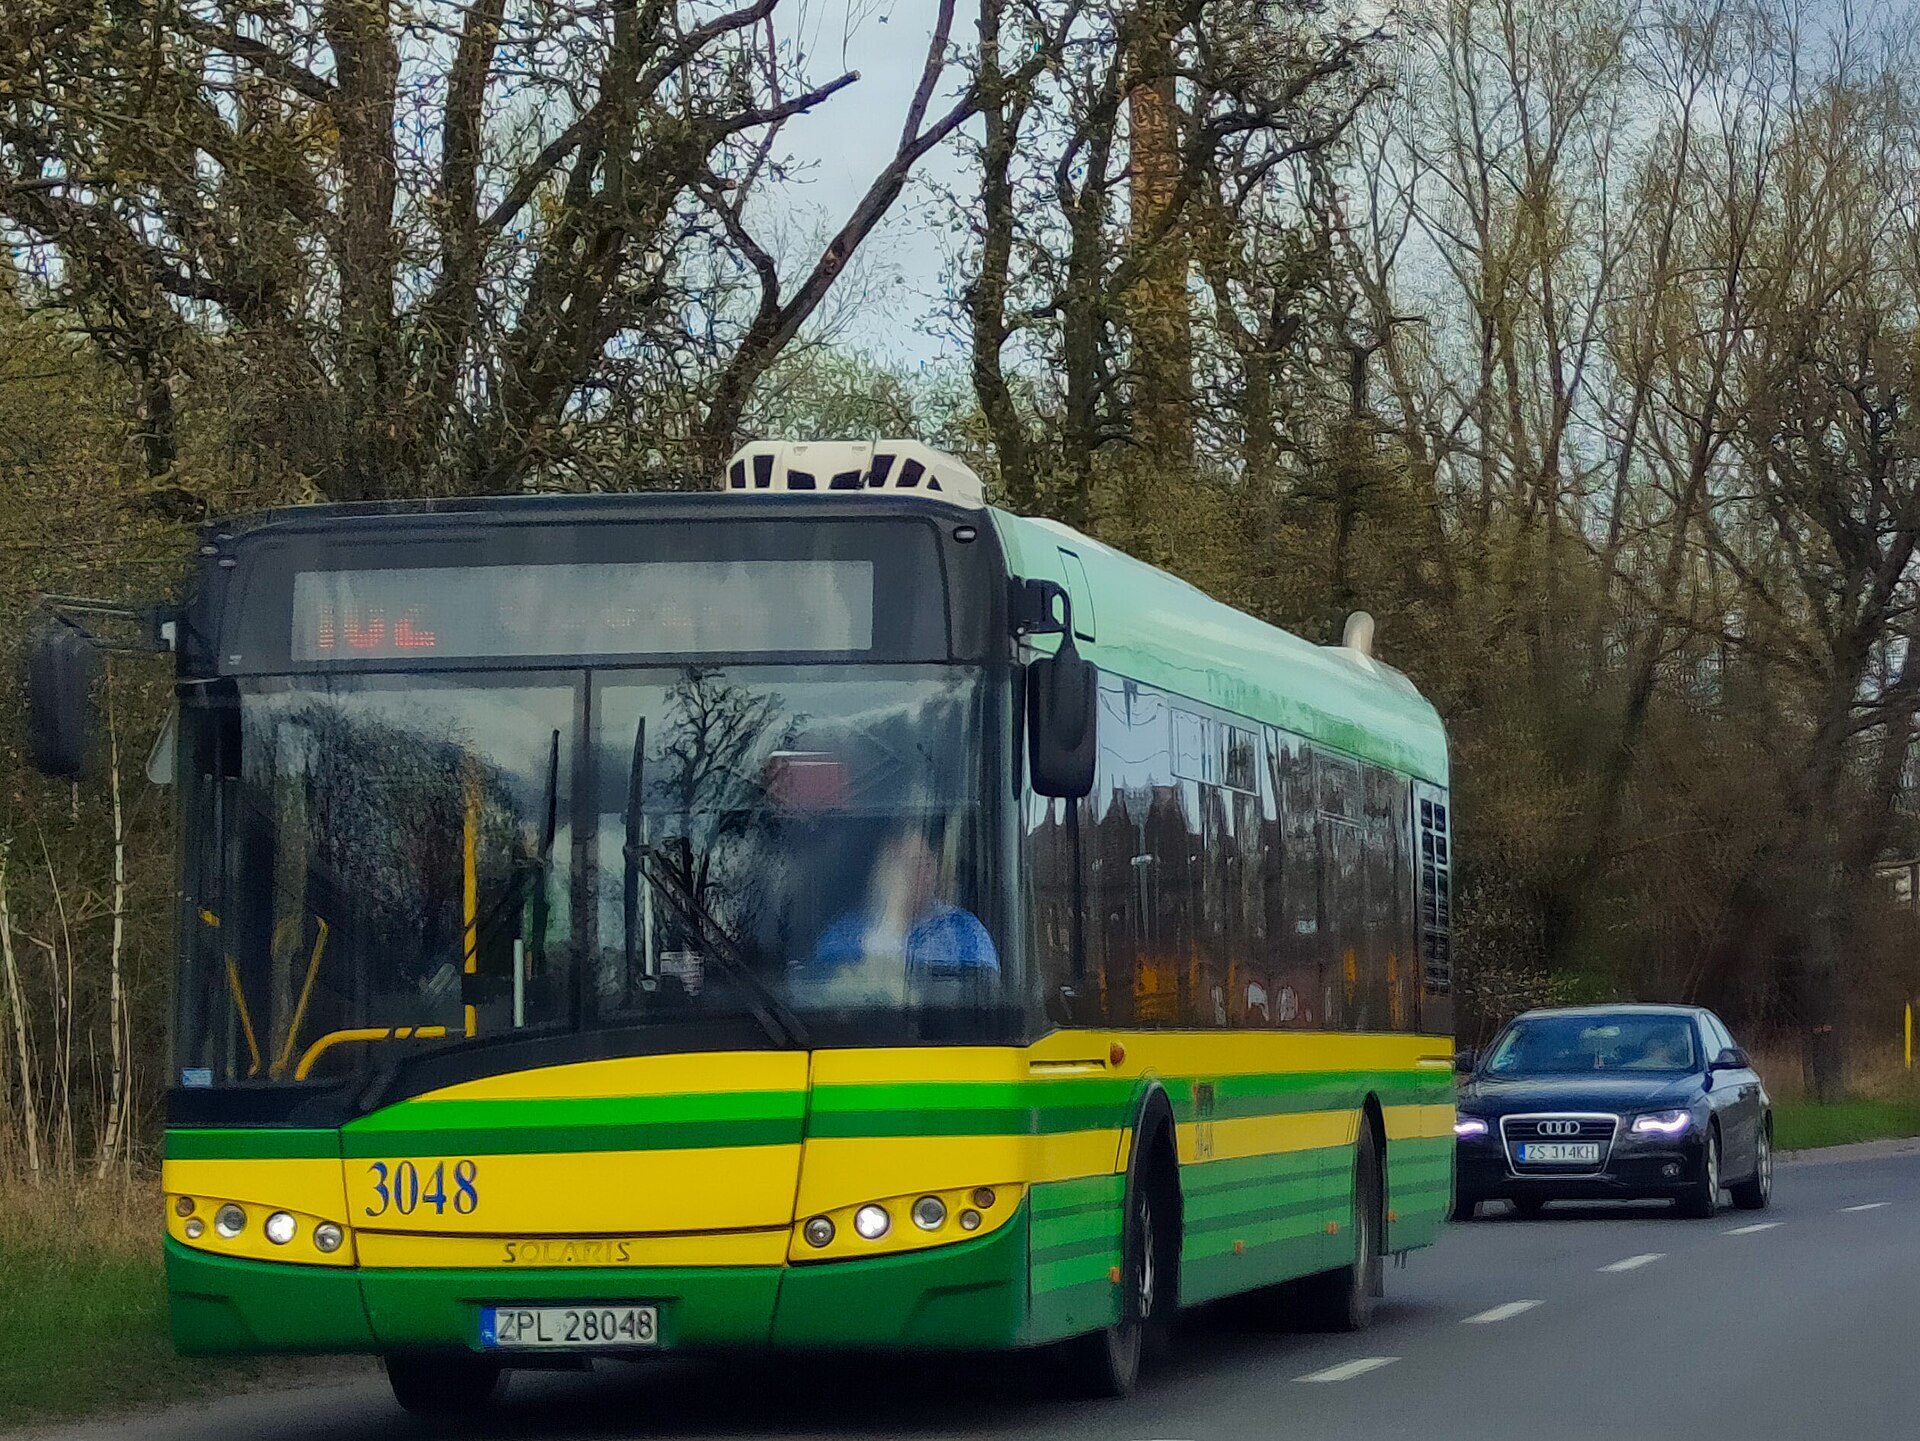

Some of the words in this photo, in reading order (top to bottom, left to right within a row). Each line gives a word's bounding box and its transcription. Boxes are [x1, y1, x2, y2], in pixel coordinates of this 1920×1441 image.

[1528, 1145, 1546, 1159] ZS
[365, 1159, 479, 1217] 3048
[502, 1240, 630, 1263] SOLARIS
[497, 1310, 553, 1342] ZPL
[564, 1309, 653, 1342] 28048
